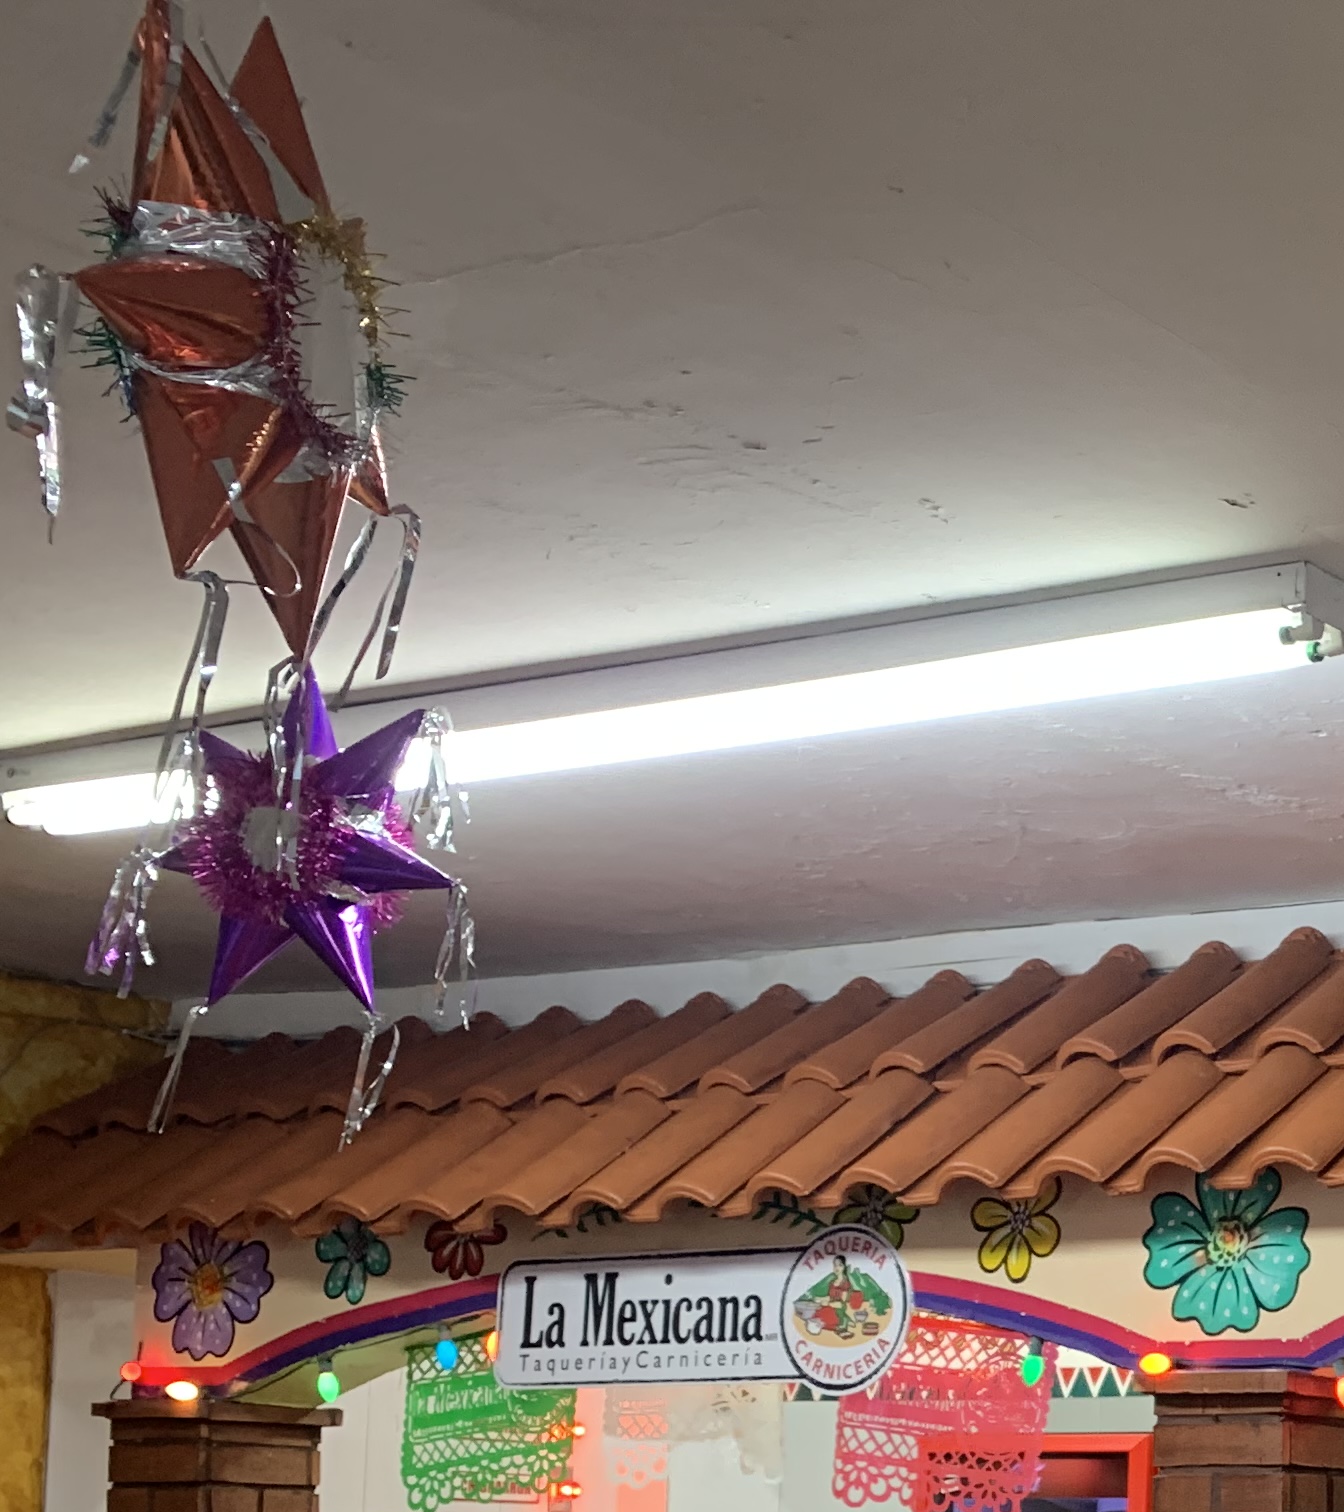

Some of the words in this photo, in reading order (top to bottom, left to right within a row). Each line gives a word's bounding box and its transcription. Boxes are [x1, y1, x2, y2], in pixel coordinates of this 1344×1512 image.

[803, 1236, 888, 1272] TAQUERIA
[520, 1276, 565, 1350] La
[579, 1272, 763, 1348] Mexicana
[793, 1337, 892, 1380] CARNICERIA
